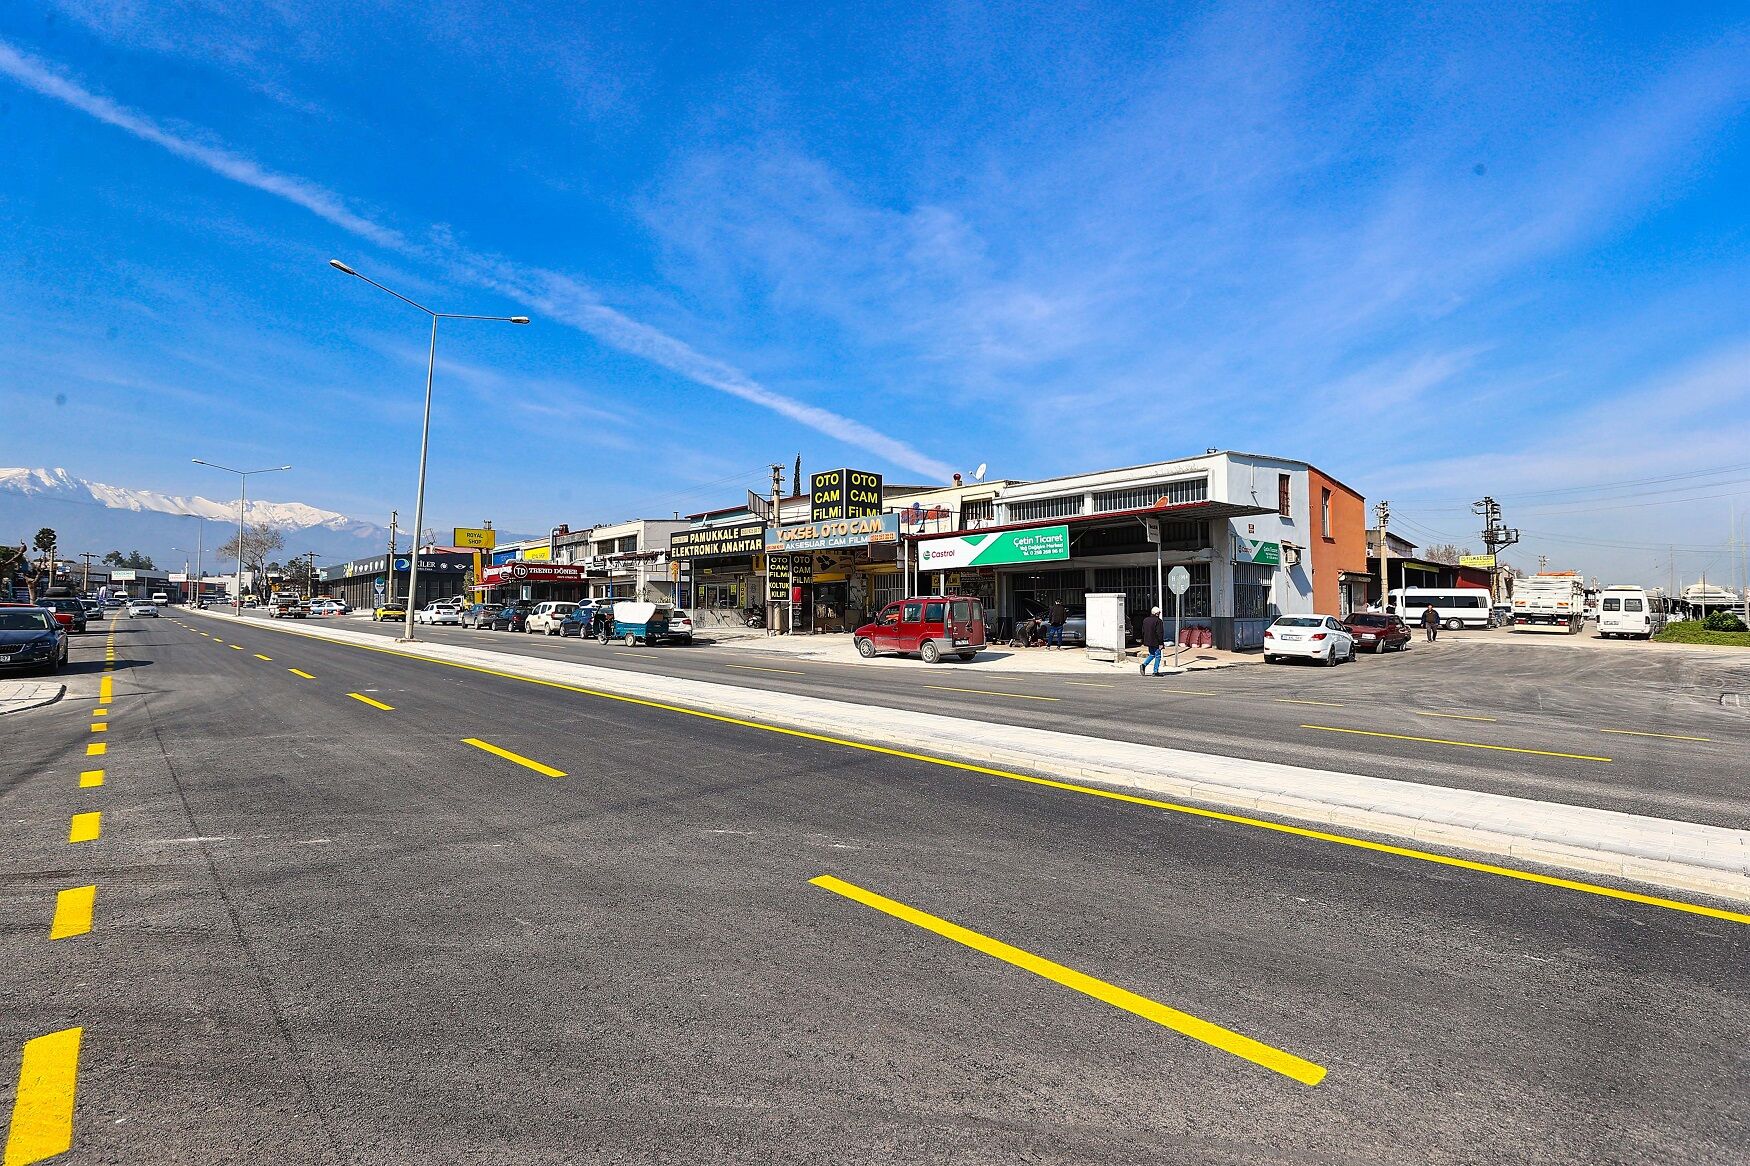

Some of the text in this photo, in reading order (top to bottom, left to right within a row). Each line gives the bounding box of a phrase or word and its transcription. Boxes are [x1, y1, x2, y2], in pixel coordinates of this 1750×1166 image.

[816, 473, 839, 488] OTO
[852, 474, 877, 488] OTO
[815, 490, 840, 504] CAM
[850, 490, 878, 504] CAM
[822, 522, 850, 538] OTO
[851, 518, 882, 534] CAM
[690, 528, 738, 544] PAMUKKALE
[1014, 534, 1063, 548] Çetin Ticaret
[721, 539, 762, 553] ANAHTAR
[786, 540, 826, 550] AKSESUAR
[828, 538, 846, 547] CAM
[932, 550, 955, 558] Castrol
